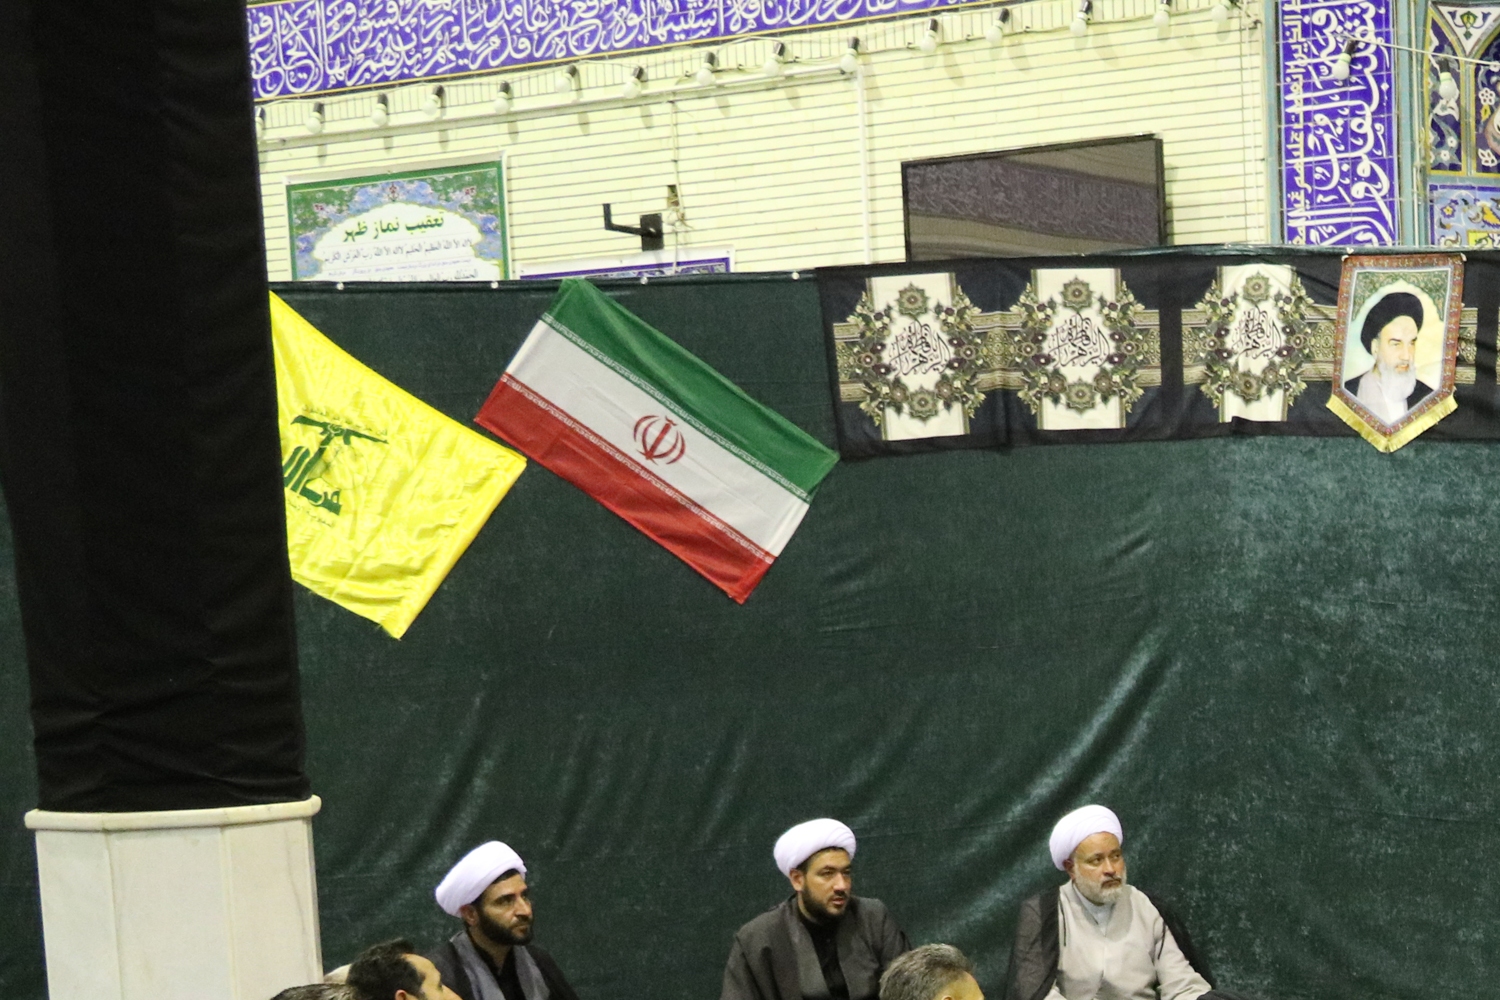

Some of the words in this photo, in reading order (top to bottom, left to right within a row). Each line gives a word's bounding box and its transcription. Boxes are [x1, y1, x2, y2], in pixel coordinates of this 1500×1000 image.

[343, 220, 368, 242] ظهر
[373, 216, 400, 240] نماز
[405, 211, 444, 235] تعقیب
